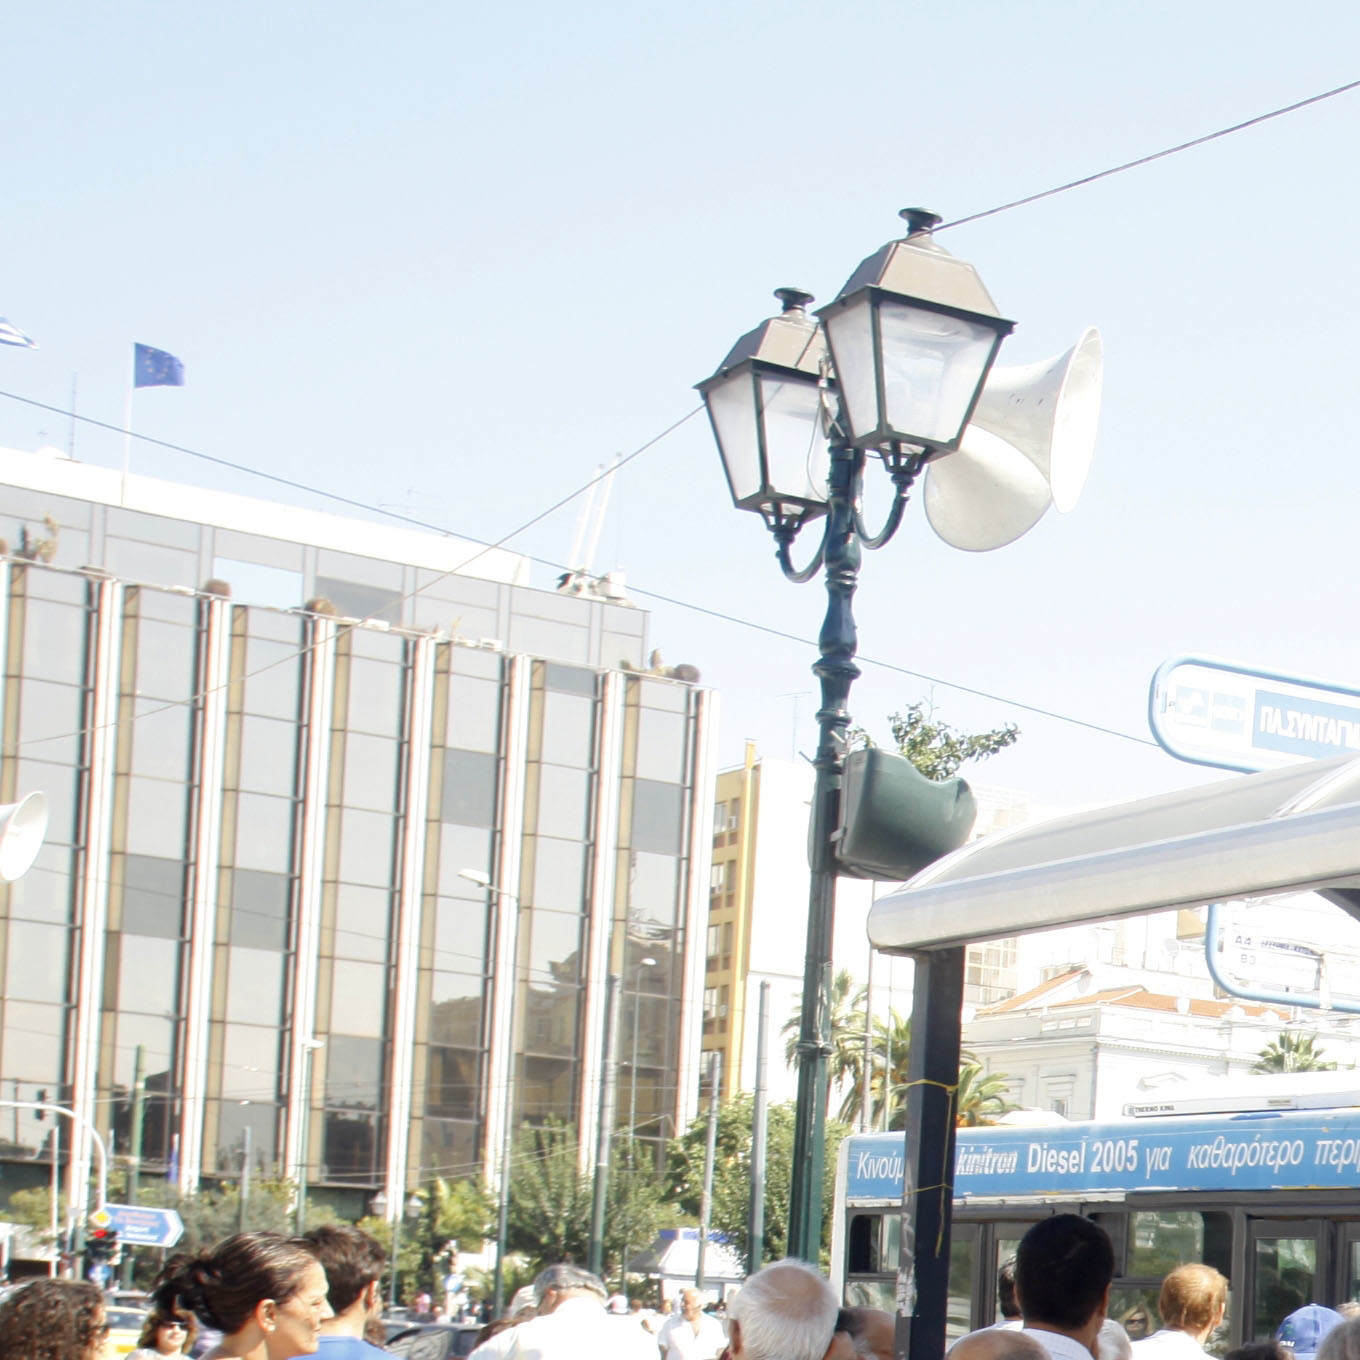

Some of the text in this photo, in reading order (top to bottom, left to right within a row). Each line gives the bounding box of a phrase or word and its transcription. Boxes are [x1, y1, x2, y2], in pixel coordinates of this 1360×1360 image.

[956, 1147, 1018, 1175] kinitron
[1027, 1135, 1085, 1174] Diesel
[1090, 1140, 1139, 1173] 2005
[1145, 1146, 1172, 1179] για
[1187, 1134, 1304, 1175] καθαρότερο
